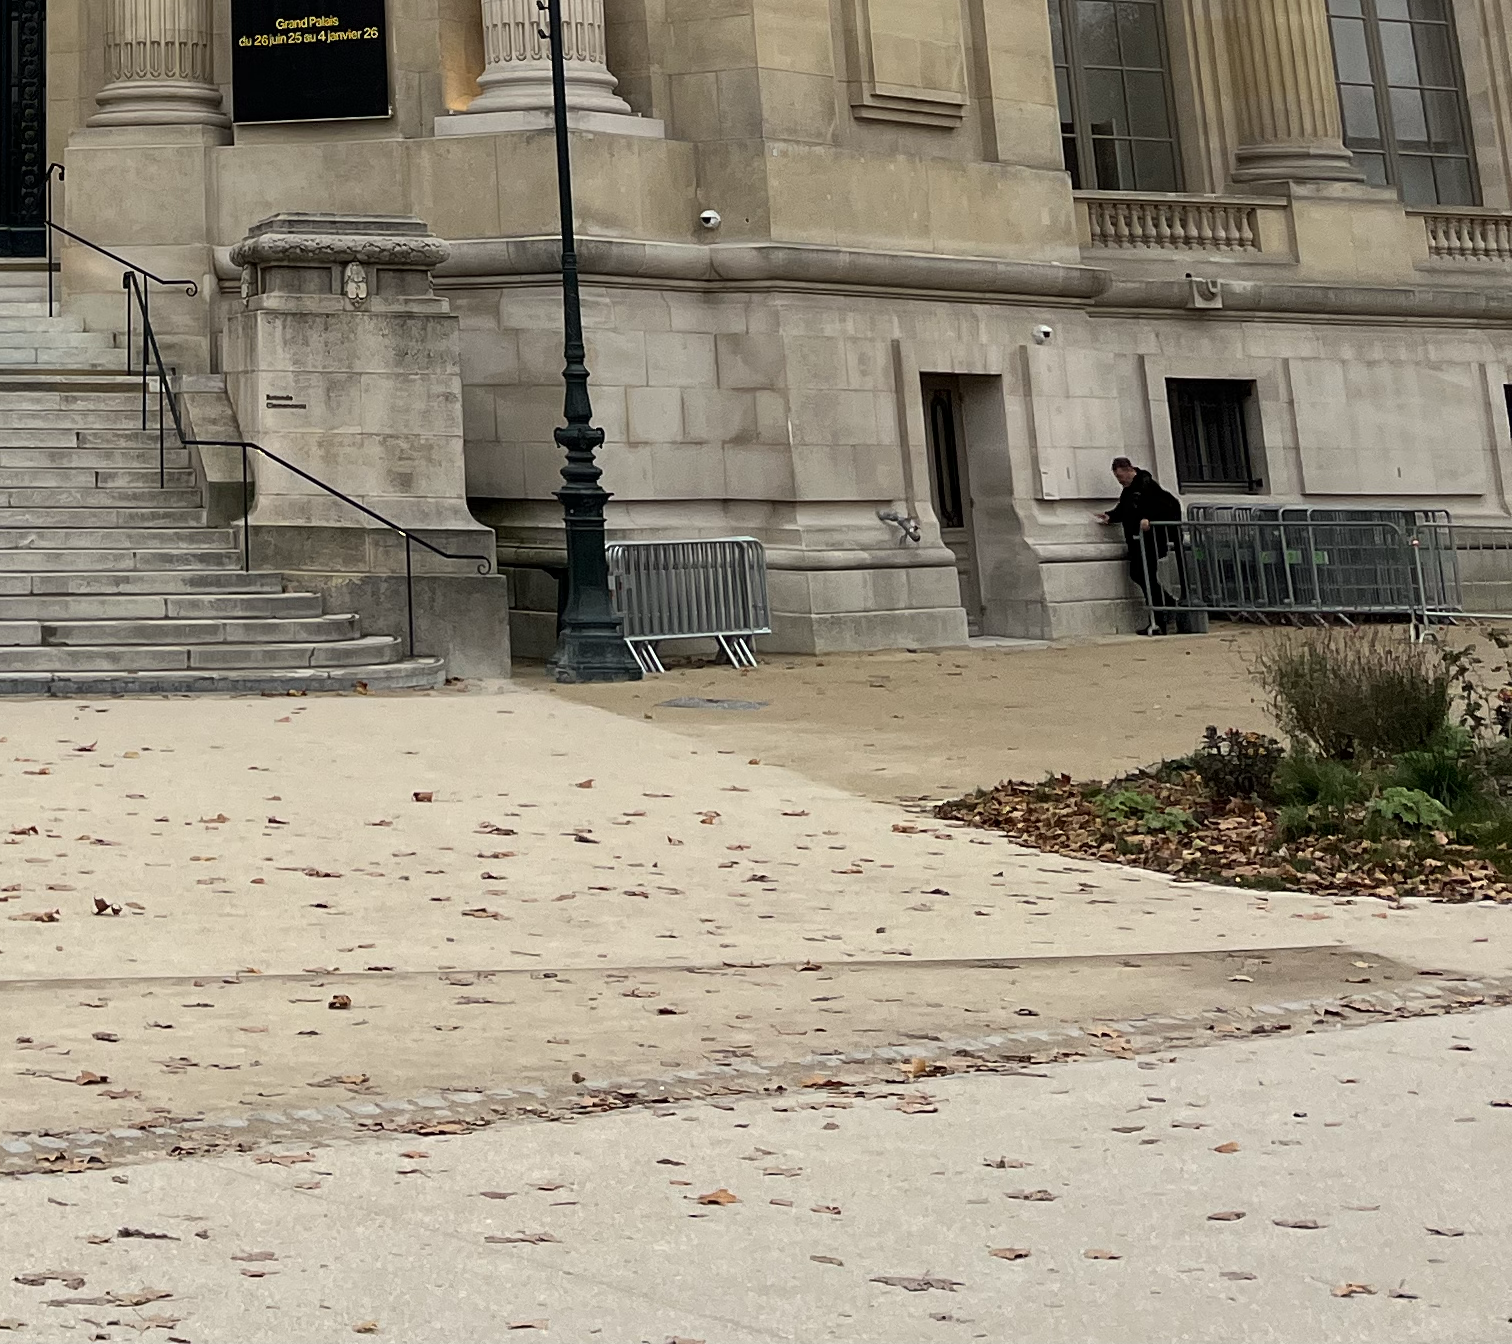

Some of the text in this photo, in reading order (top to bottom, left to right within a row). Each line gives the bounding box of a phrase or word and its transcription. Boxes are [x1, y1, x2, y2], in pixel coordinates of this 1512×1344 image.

[275, 15, 339, 29] Grand Palais
[238, 27, 378, 47] du 26 juin 25 au 4 janvier 26
